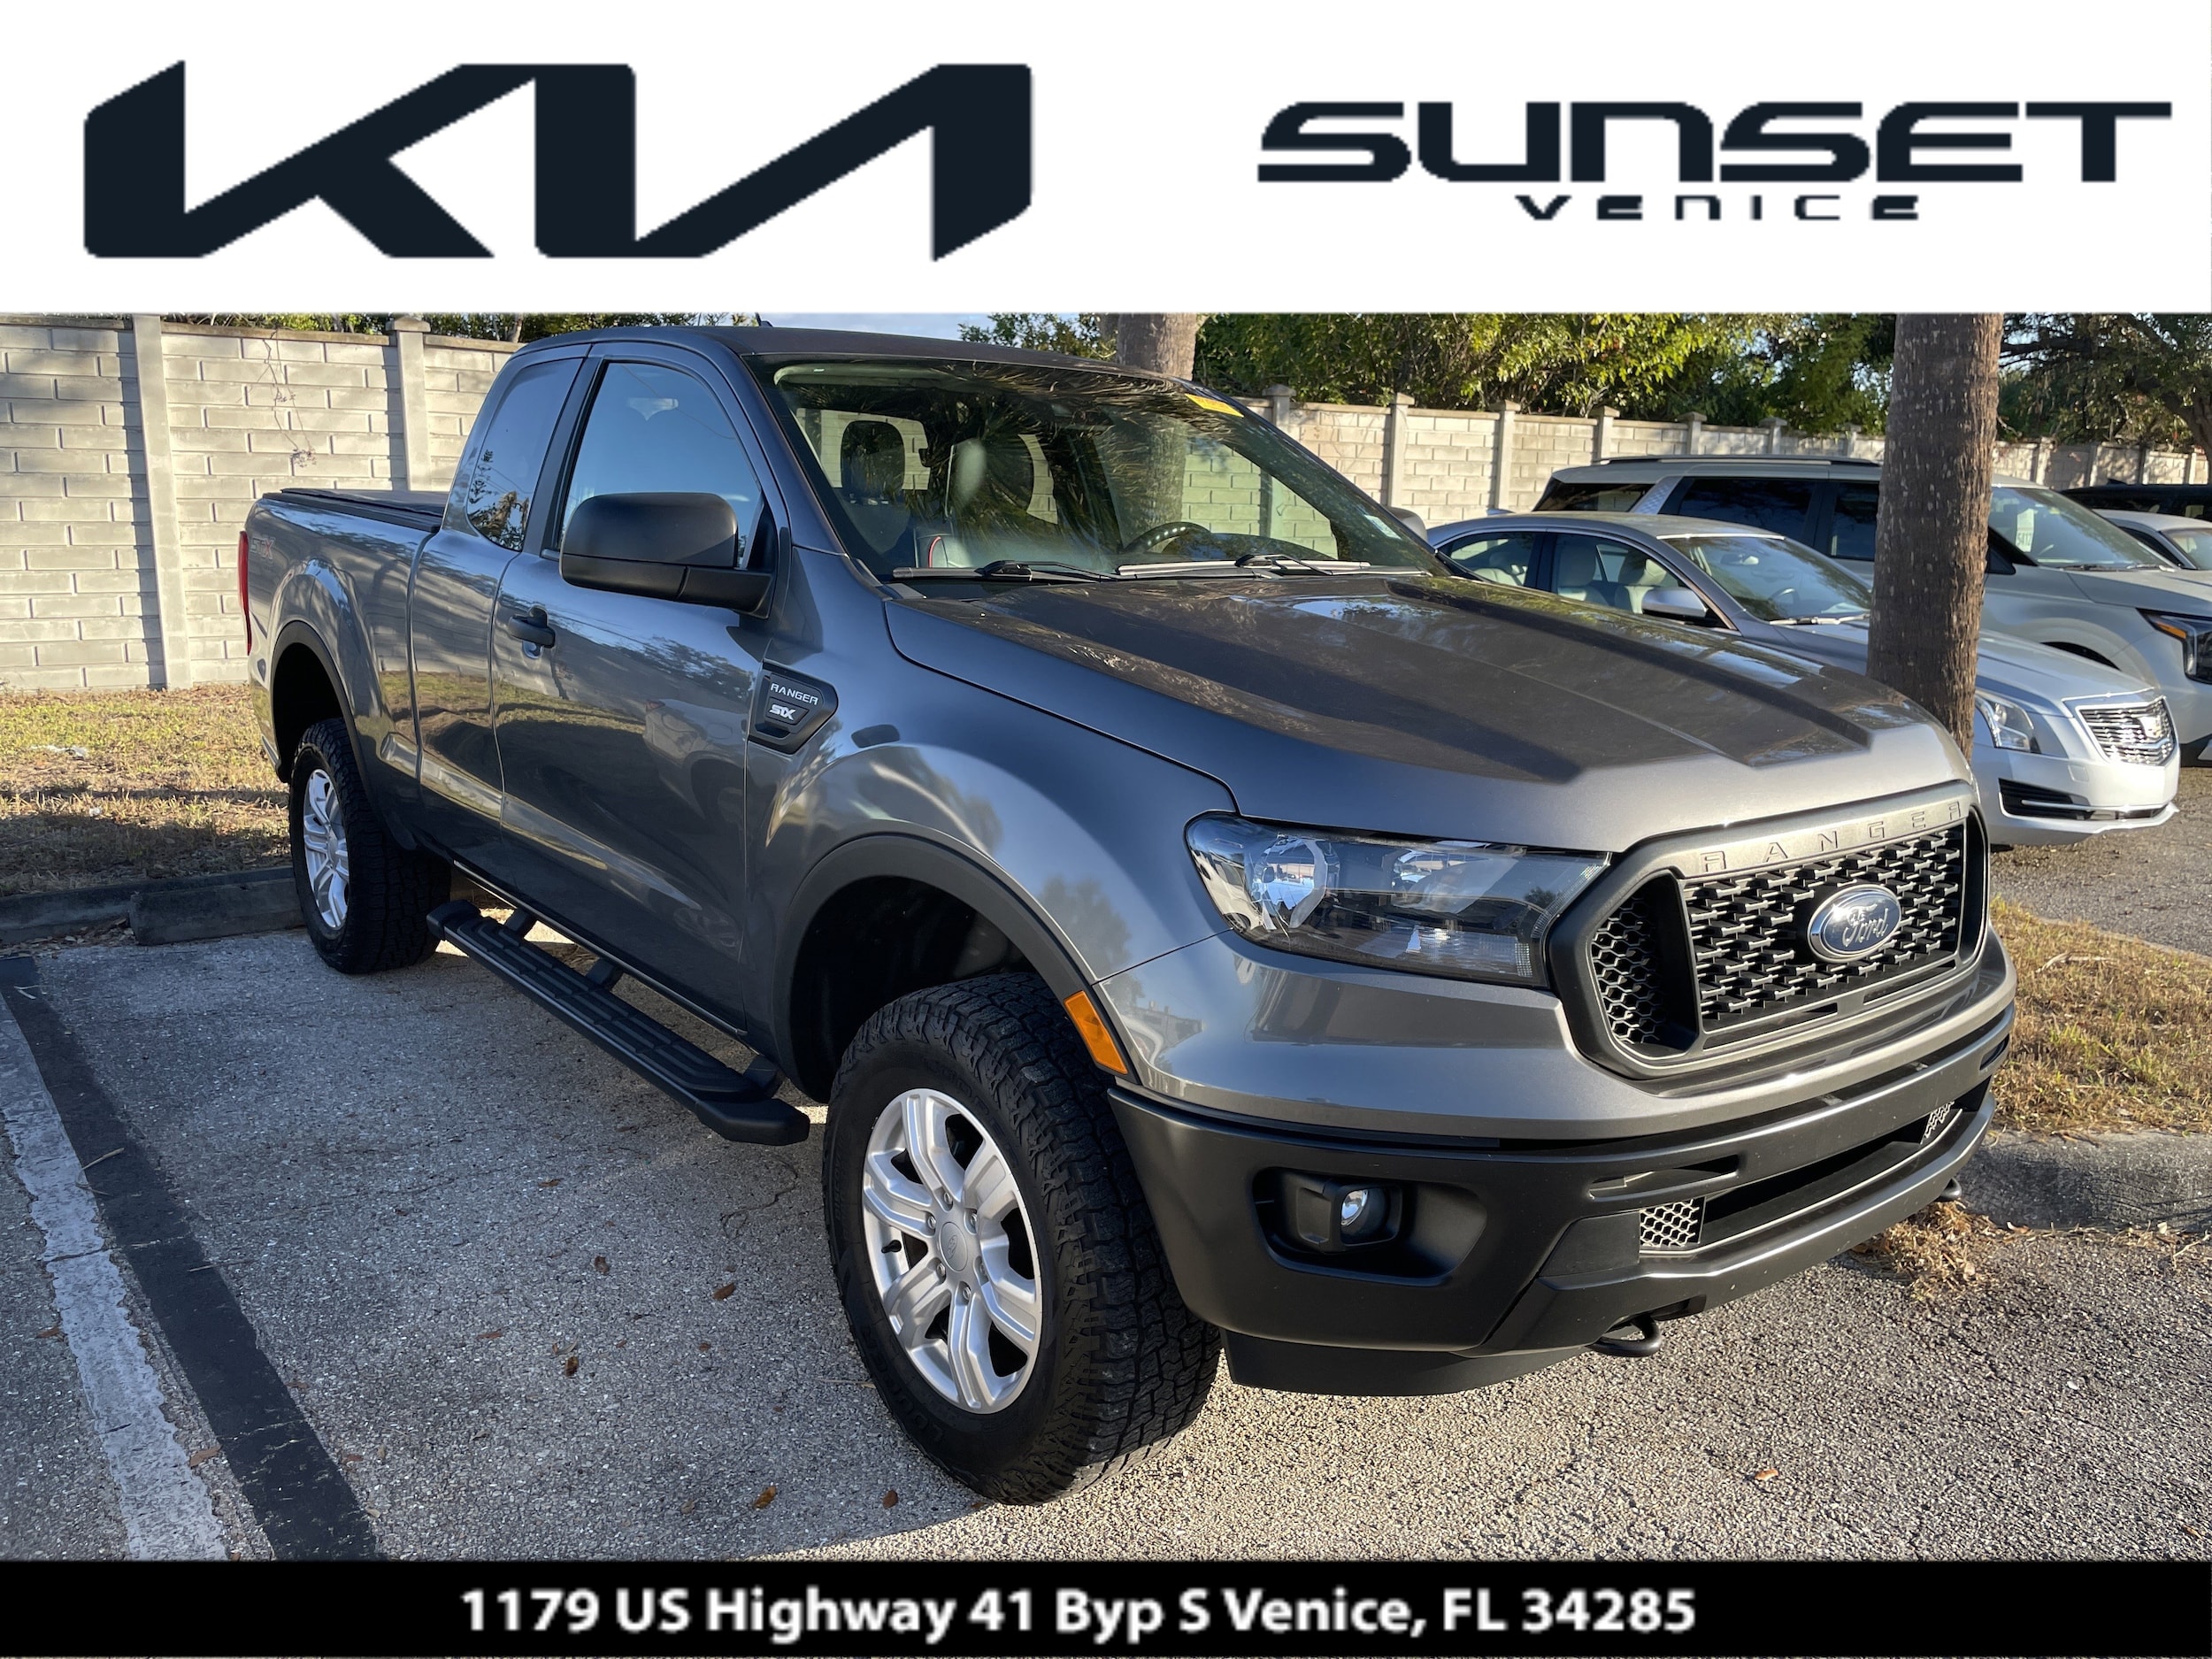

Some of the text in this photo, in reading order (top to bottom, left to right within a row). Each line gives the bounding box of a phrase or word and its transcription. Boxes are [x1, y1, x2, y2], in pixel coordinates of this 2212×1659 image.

[770, 682, 819, 706] RANGER
[768, 703, 796, 721] STX
[1699, 800, 1962, 872] RANGER
[1840, 902, 1890, 948] Ford
